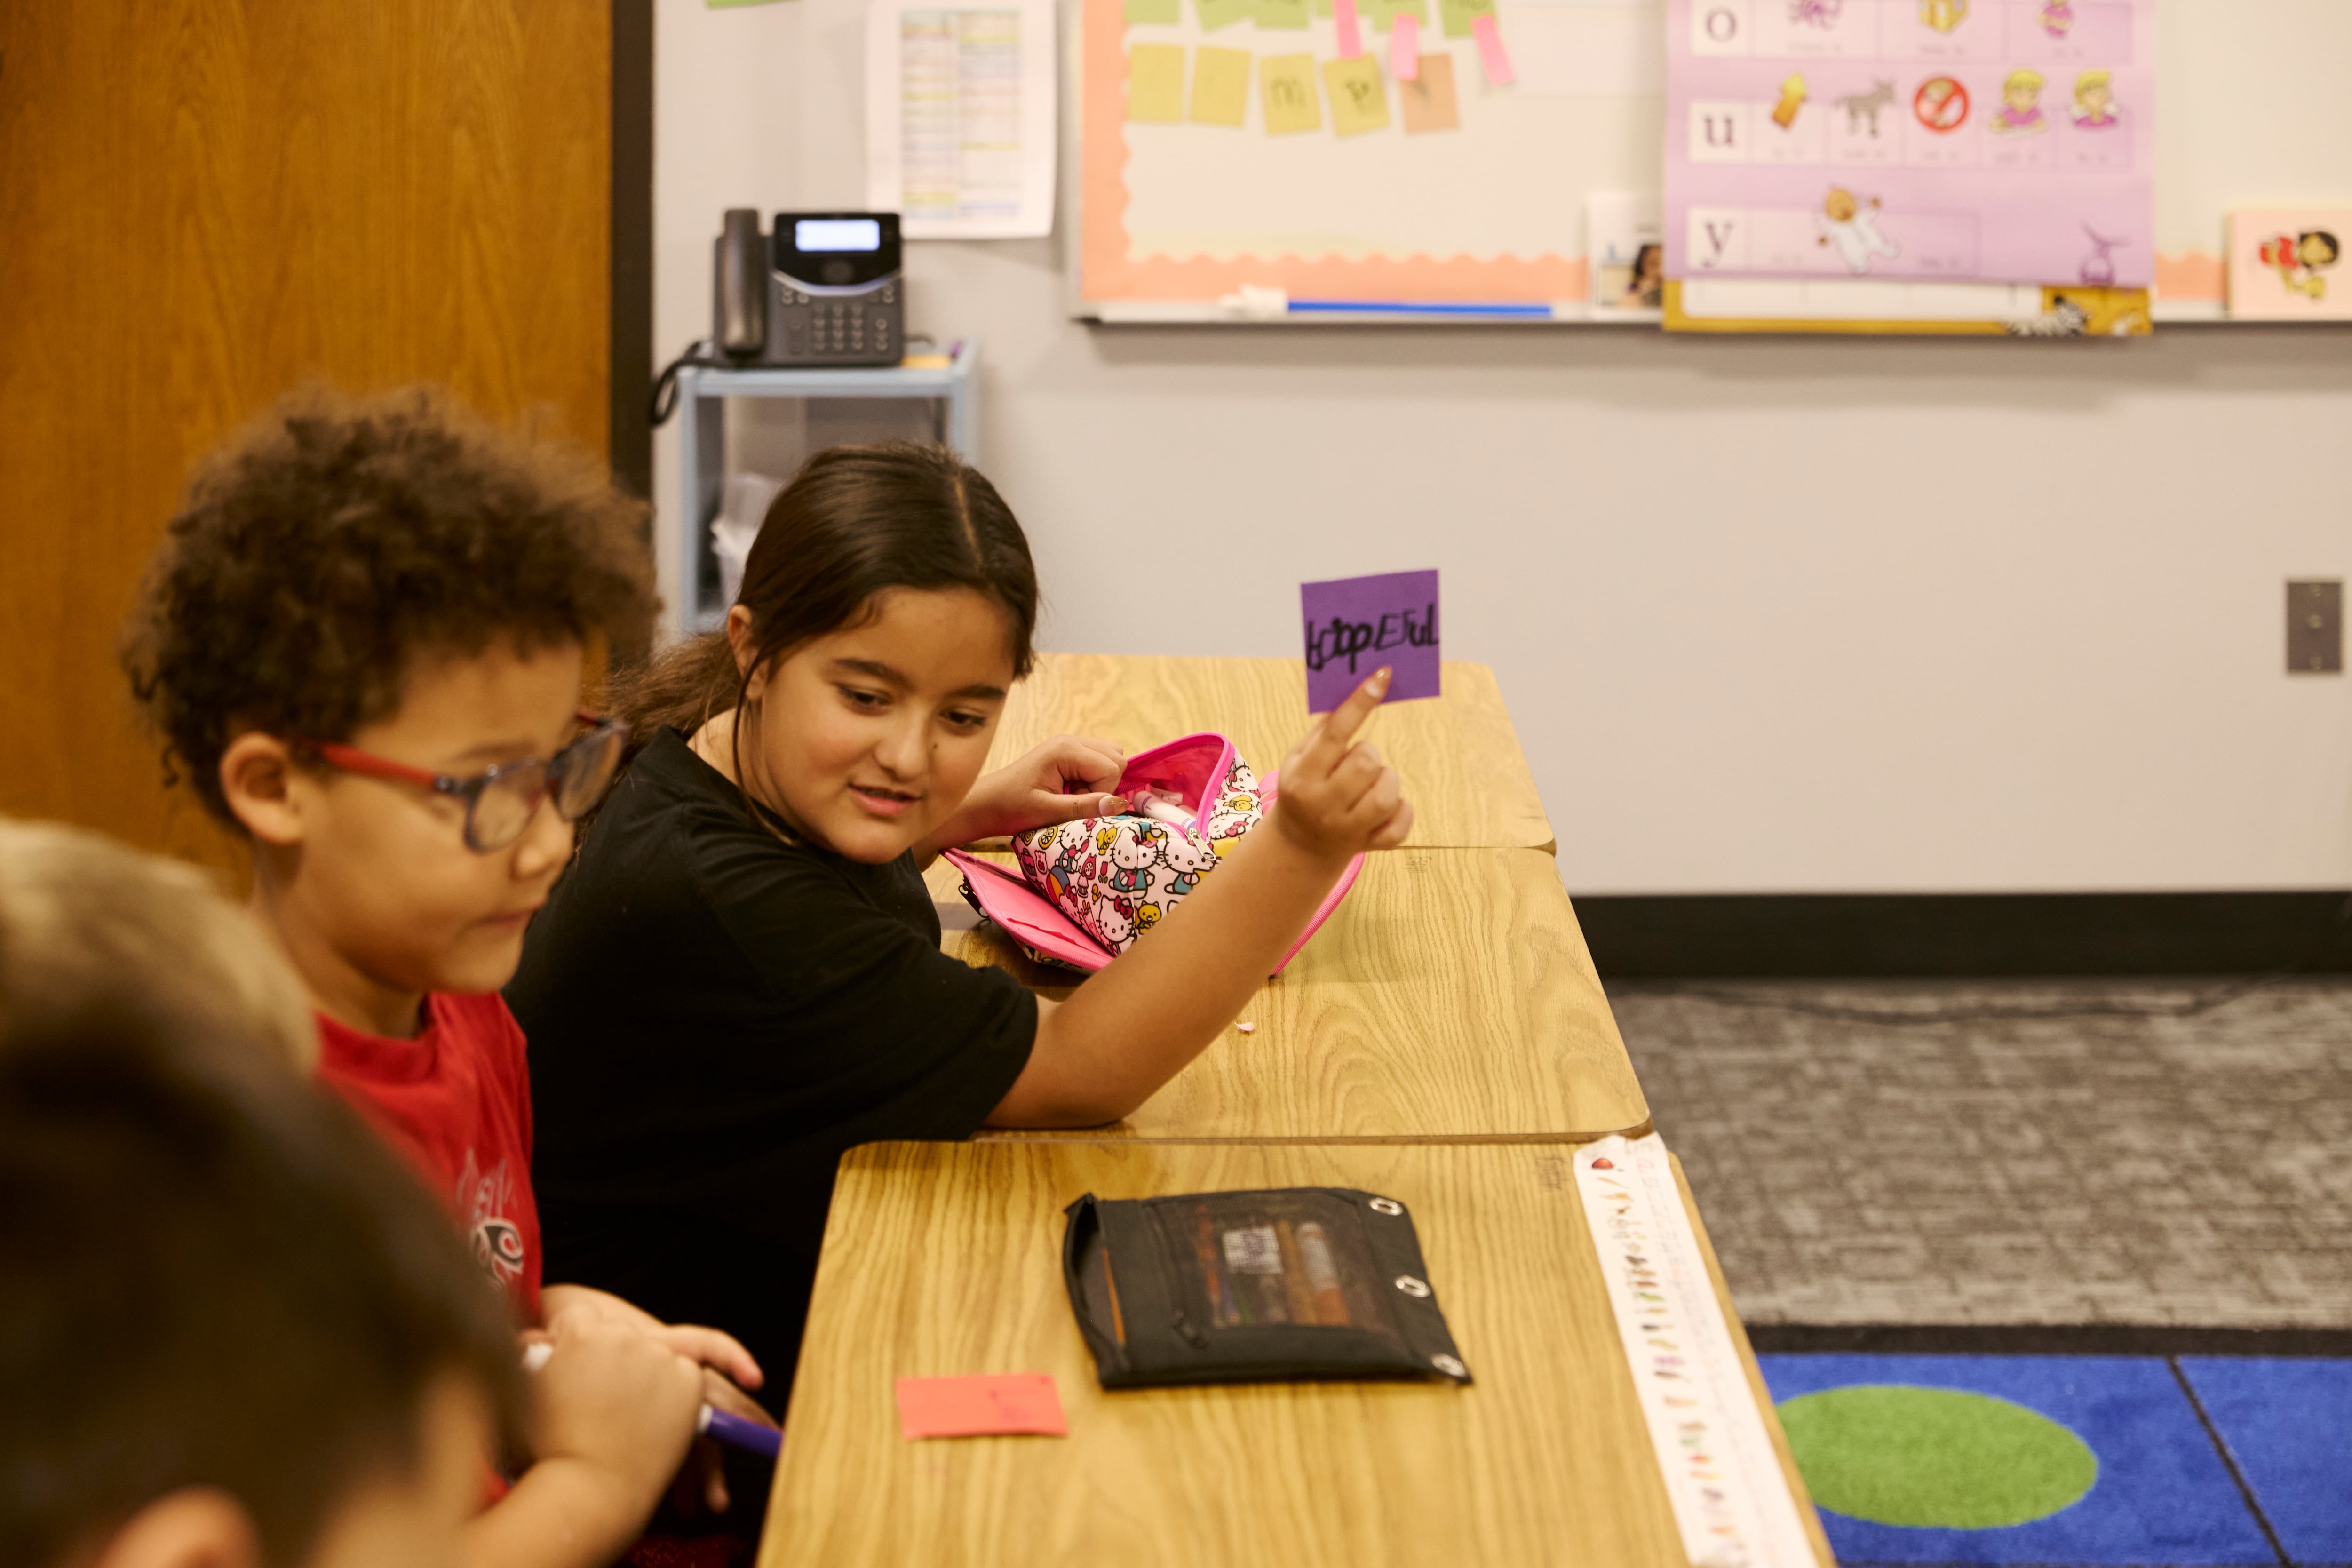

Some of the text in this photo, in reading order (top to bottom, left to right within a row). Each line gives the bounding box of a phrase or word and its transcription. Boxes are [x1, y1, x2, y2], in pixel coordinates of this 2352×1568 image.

[1705, 8, 1737, 42] o
[1703, 113, 1735, 147] u
[1701, 219, 1733, 269] y
